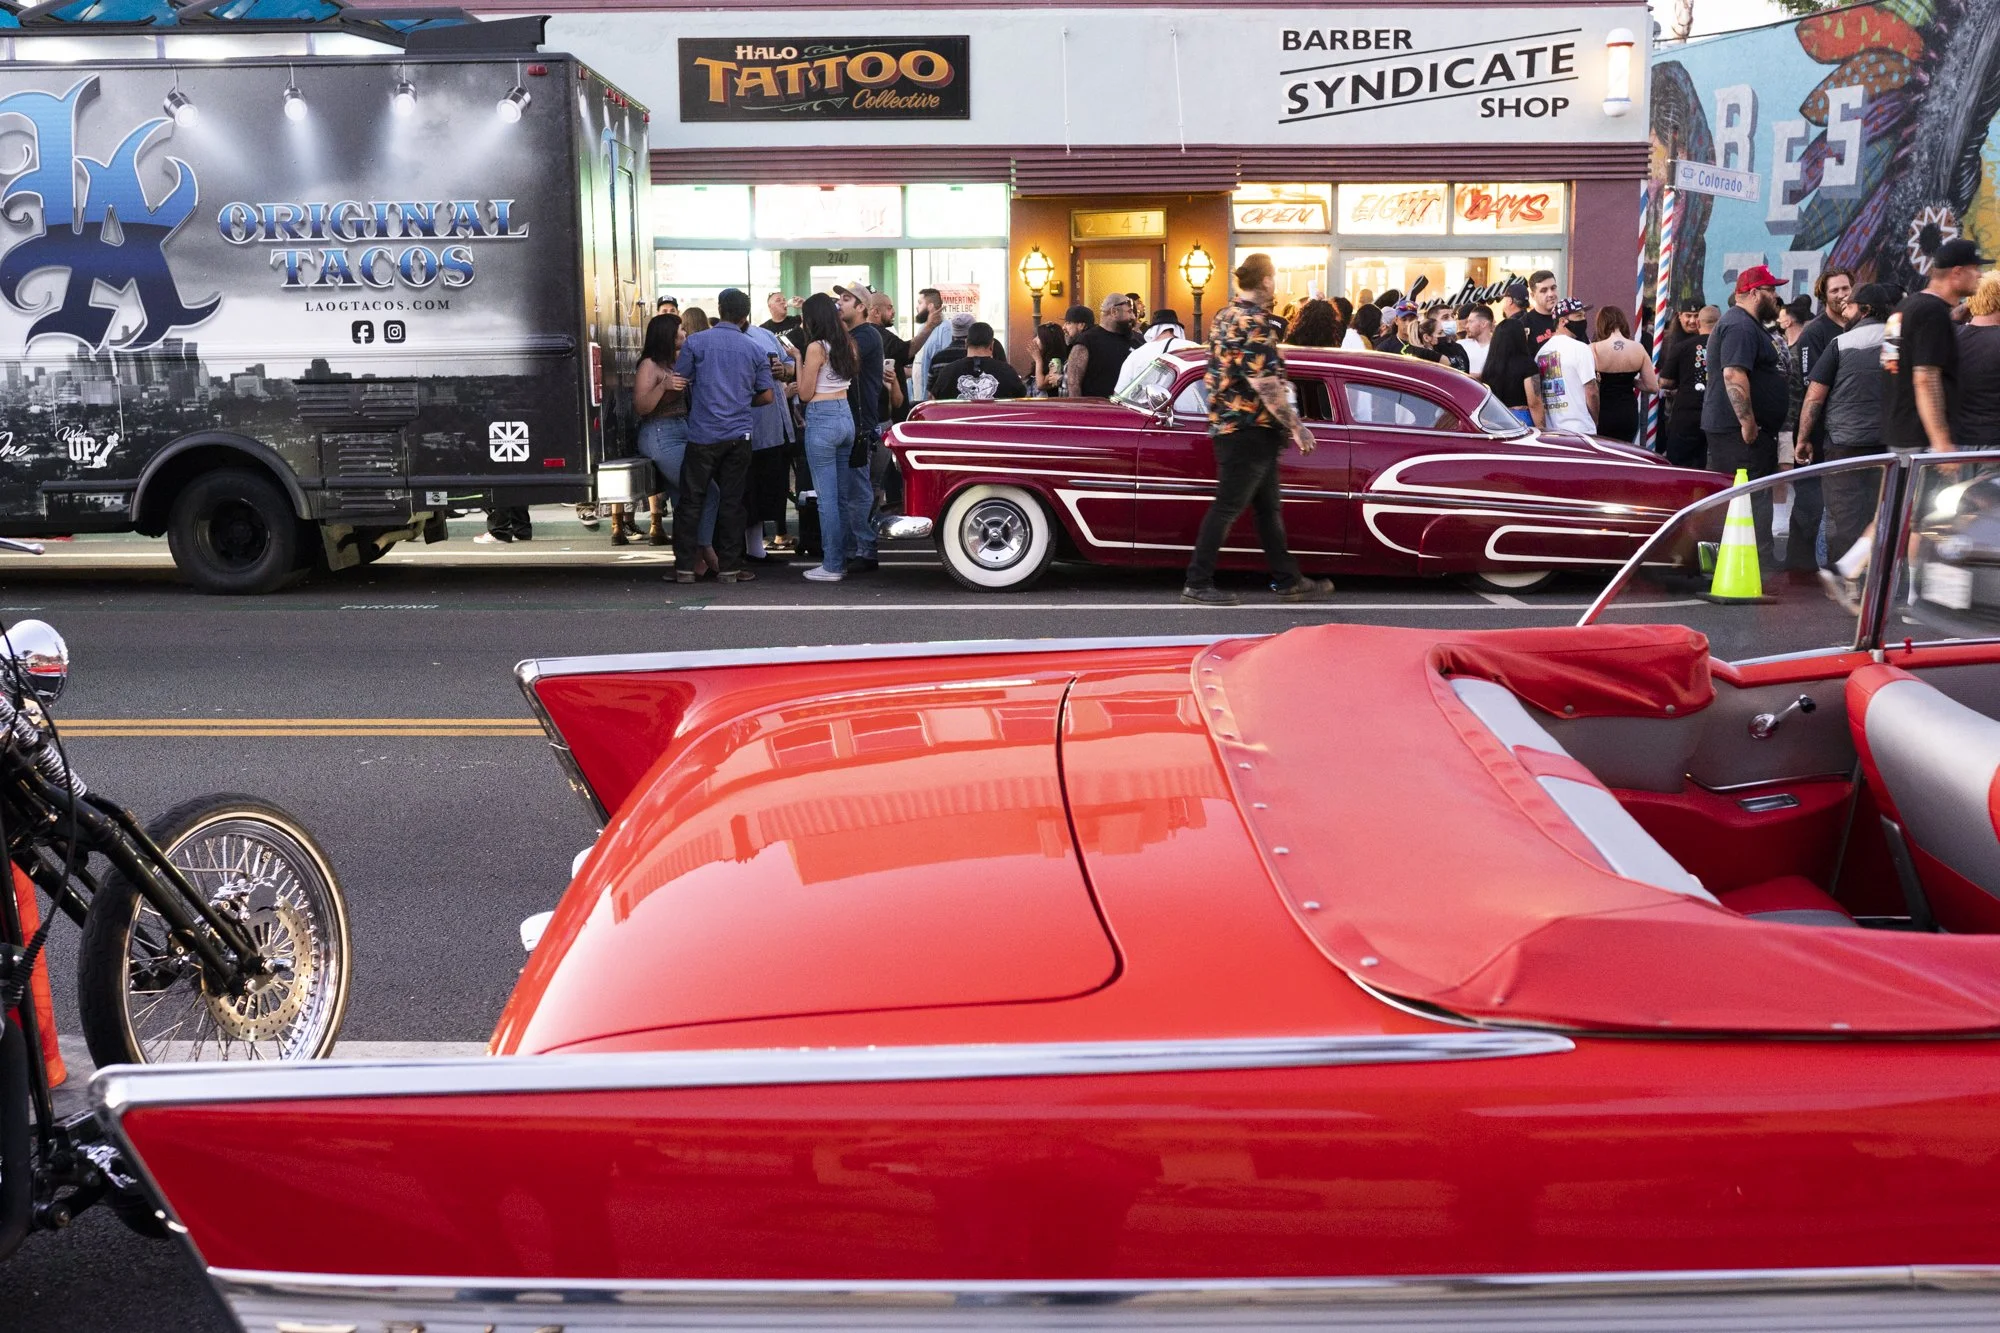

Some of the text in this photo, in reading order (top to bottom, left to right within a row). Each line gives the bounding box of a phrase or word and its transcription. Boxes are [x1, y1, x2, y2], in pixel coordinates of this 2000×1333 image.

[1282, 29, 1413, 50] BARBER
[735, 45, 798, 60] HALO
[694, 50, 954, 104] TATTOO
[1286, 42, 1576, 115] SYNDICATE
[852, 89, 940, 109] Collective
[1480, 97, 1570, 118] SHOP
[1698, 170, 1742, 192] Colorado
[1240, 206, 1314, 224] OPEN
[1464, 193, 1550, 221] DAYS
[217, 199, 530, 244] ORIGINAL
[270, 245, 475, 288] TACOS
[305, 299, 451, 312] LAOGTACOS.COM
[948, 304, 960, 312] THE
[67, 437, 96, 461] UP
